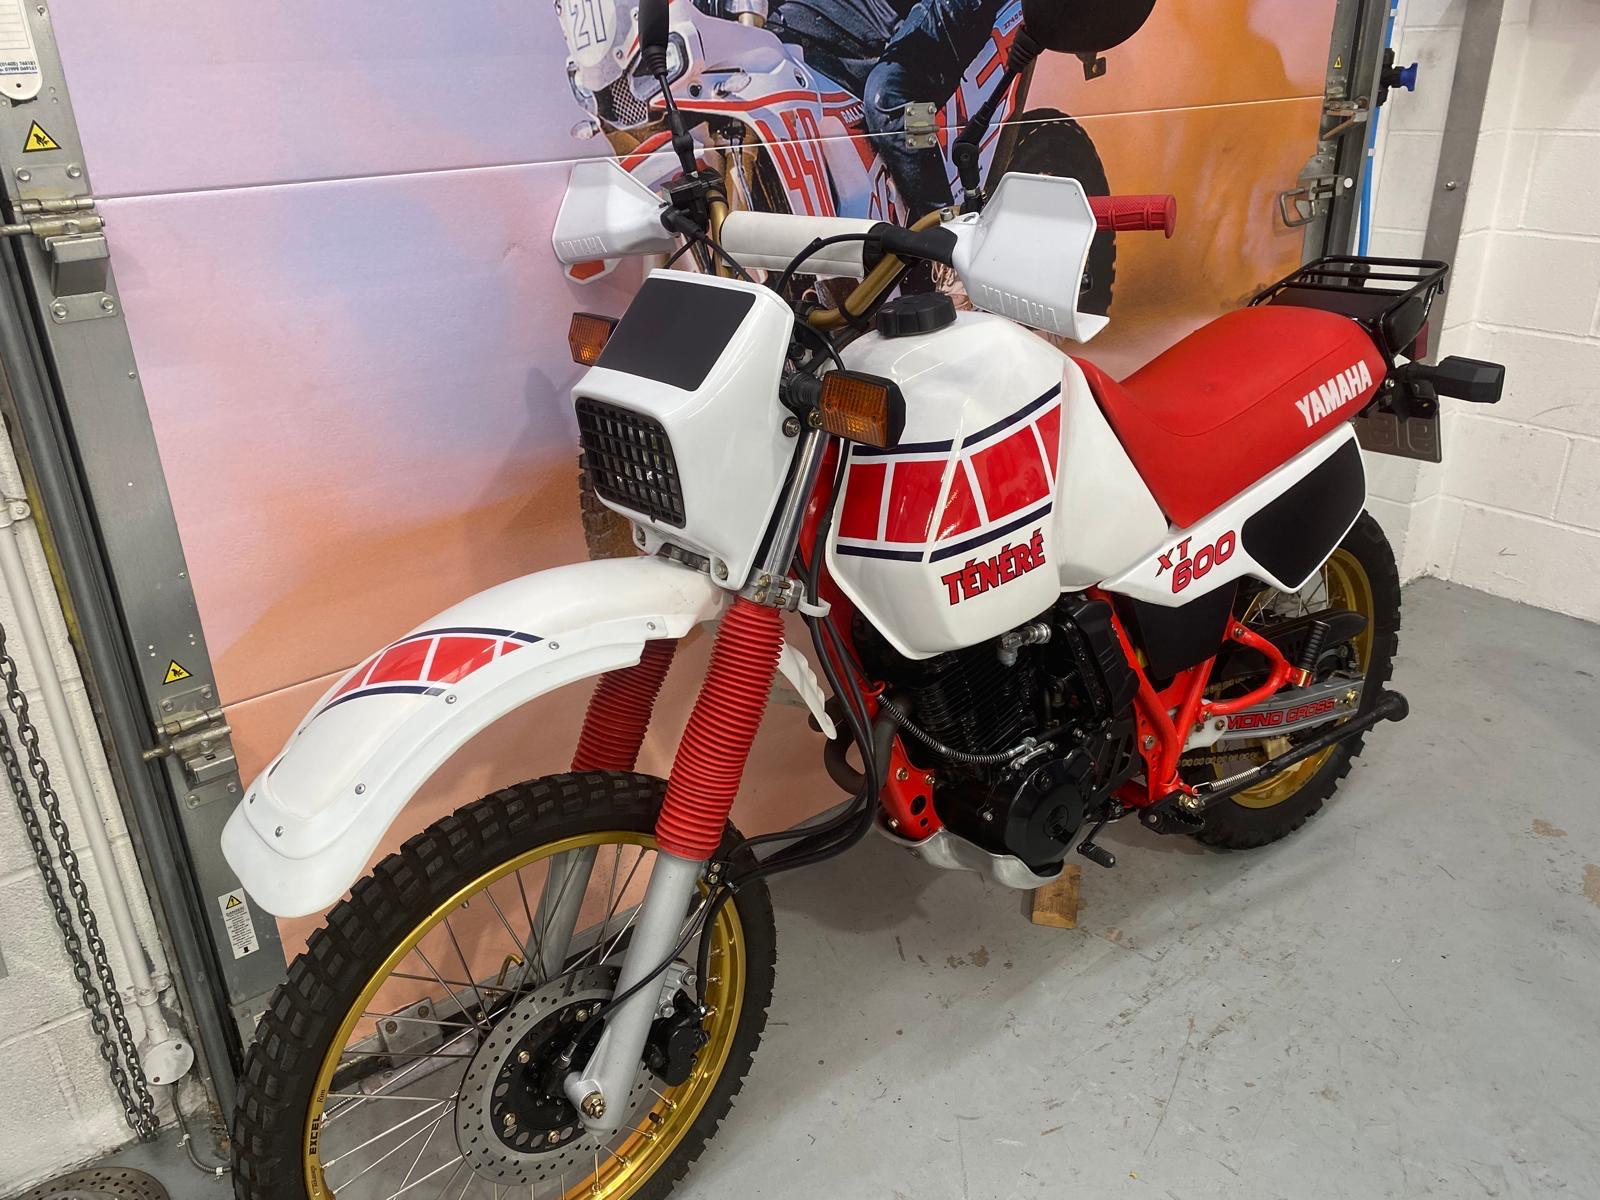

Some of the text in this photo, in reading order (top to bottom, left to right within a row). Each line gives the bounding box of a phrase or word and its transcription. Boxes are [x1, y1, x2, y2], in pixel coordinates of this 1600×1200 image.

[567, 0, 607, 51] 21
[981, 283, 1062, 331] YAMAHA
[1294, 359, 1374, 429] YAMAHA
[940, 527, 1046, 606] TÉNÉRÉ
[1155, 535, 1193, 578] XT
[1171, 529, 1236, 594] 600
[1285, 696, 1336, 723] CROSS
[308, 1113, 321, 1157] EXCEL
